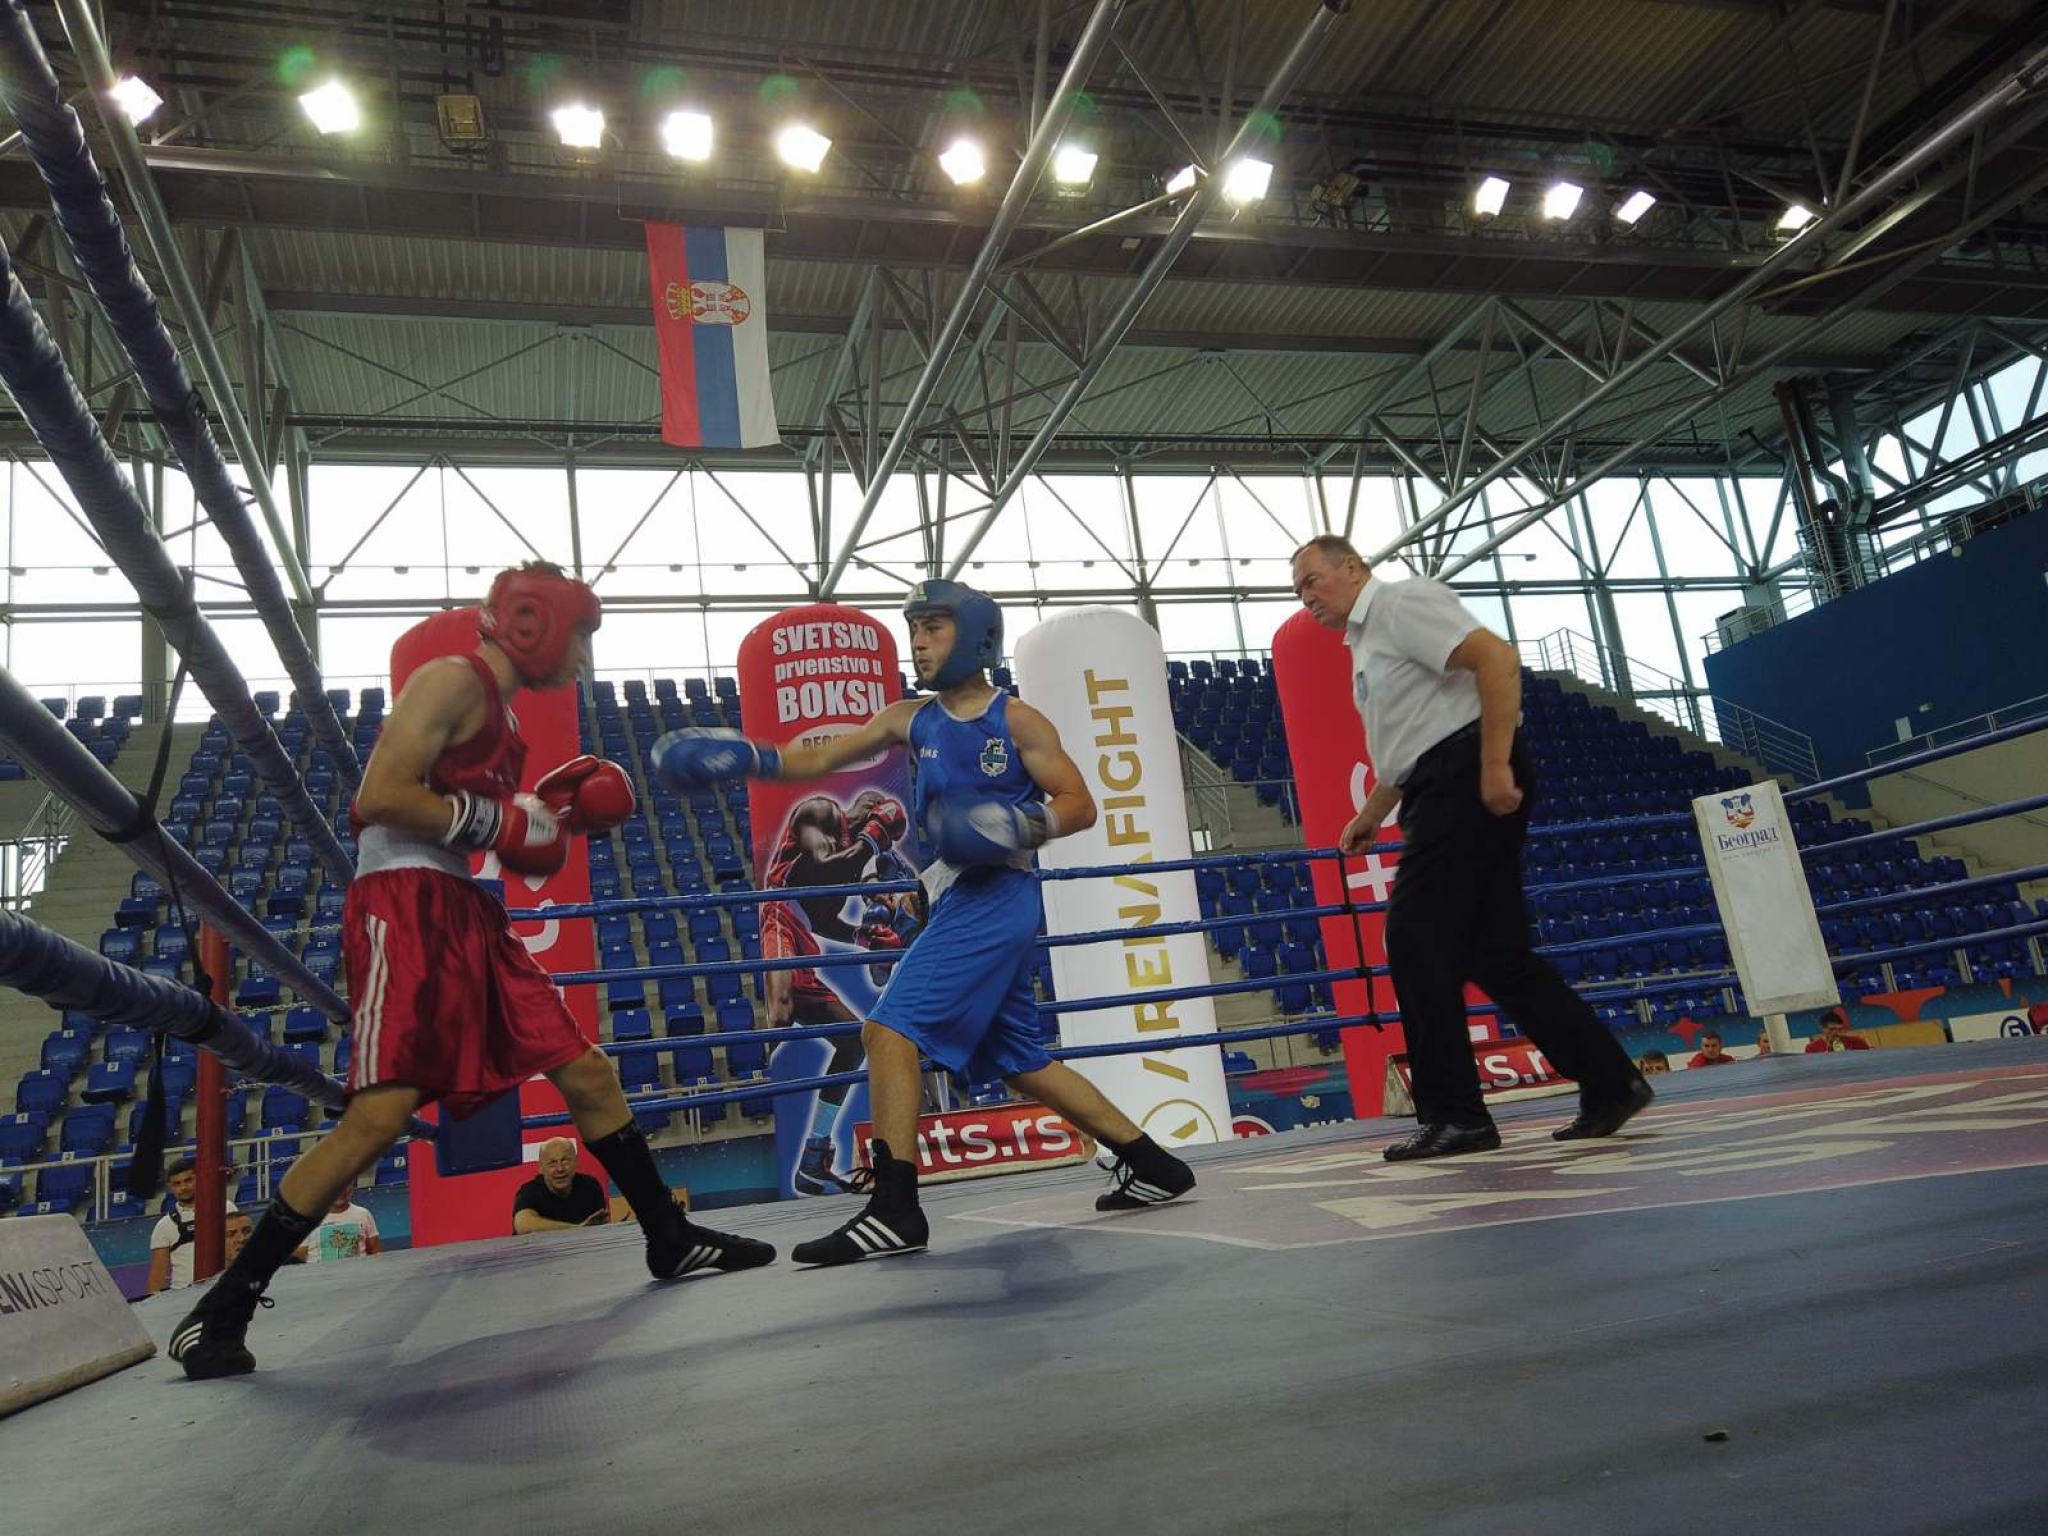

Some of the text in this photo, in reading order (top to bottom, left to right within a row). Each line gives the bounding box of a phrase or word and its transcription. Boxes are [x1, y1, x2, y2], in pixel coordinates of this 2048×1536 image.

[772, 622, 879, 655] SVETSKO
[775, 655, 883, 683] prvenstvo u
[776, 680, 888, 723] BOKSU
[1718, 827, 1779, 849] Београд
